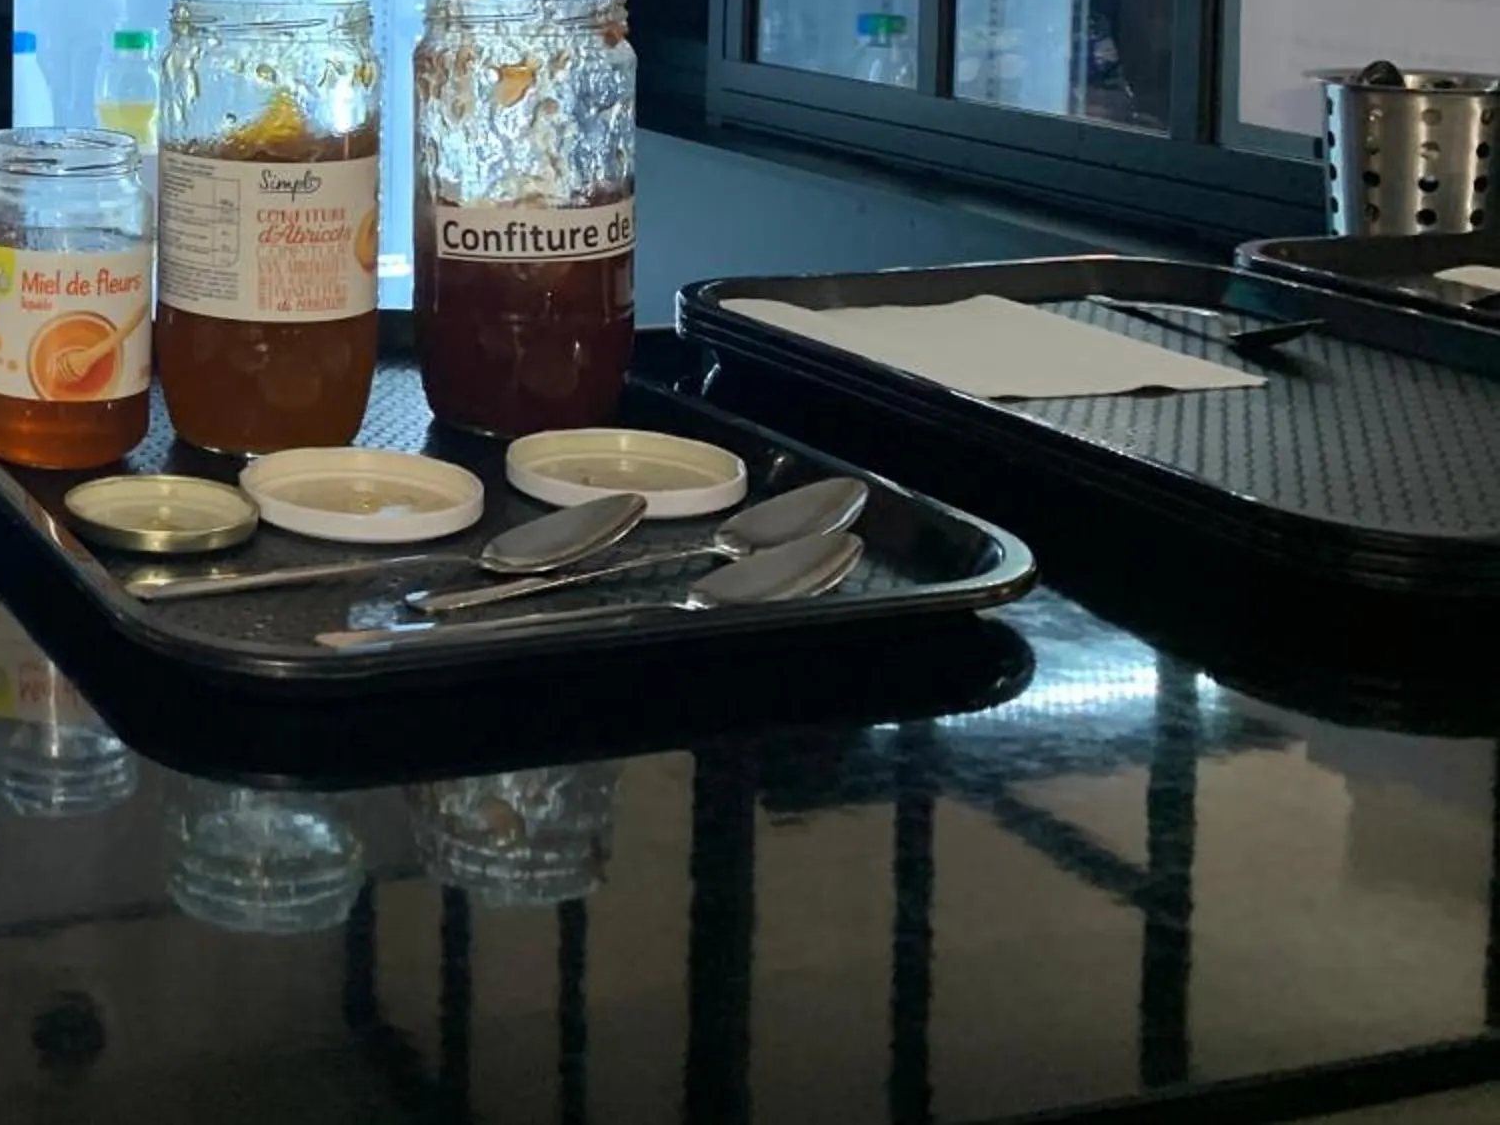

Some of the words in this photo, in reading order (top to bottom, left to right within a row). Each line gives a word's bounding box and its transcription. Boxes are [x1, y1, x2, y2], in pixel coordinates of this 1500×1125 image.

[443, 220, 599, 252] Confiture
[607, 212, 630, 244] de
[21, 270, 61, 295] Miel
[66, 270, 92, 296] de
[97, 268, 142, 295] fleurs
